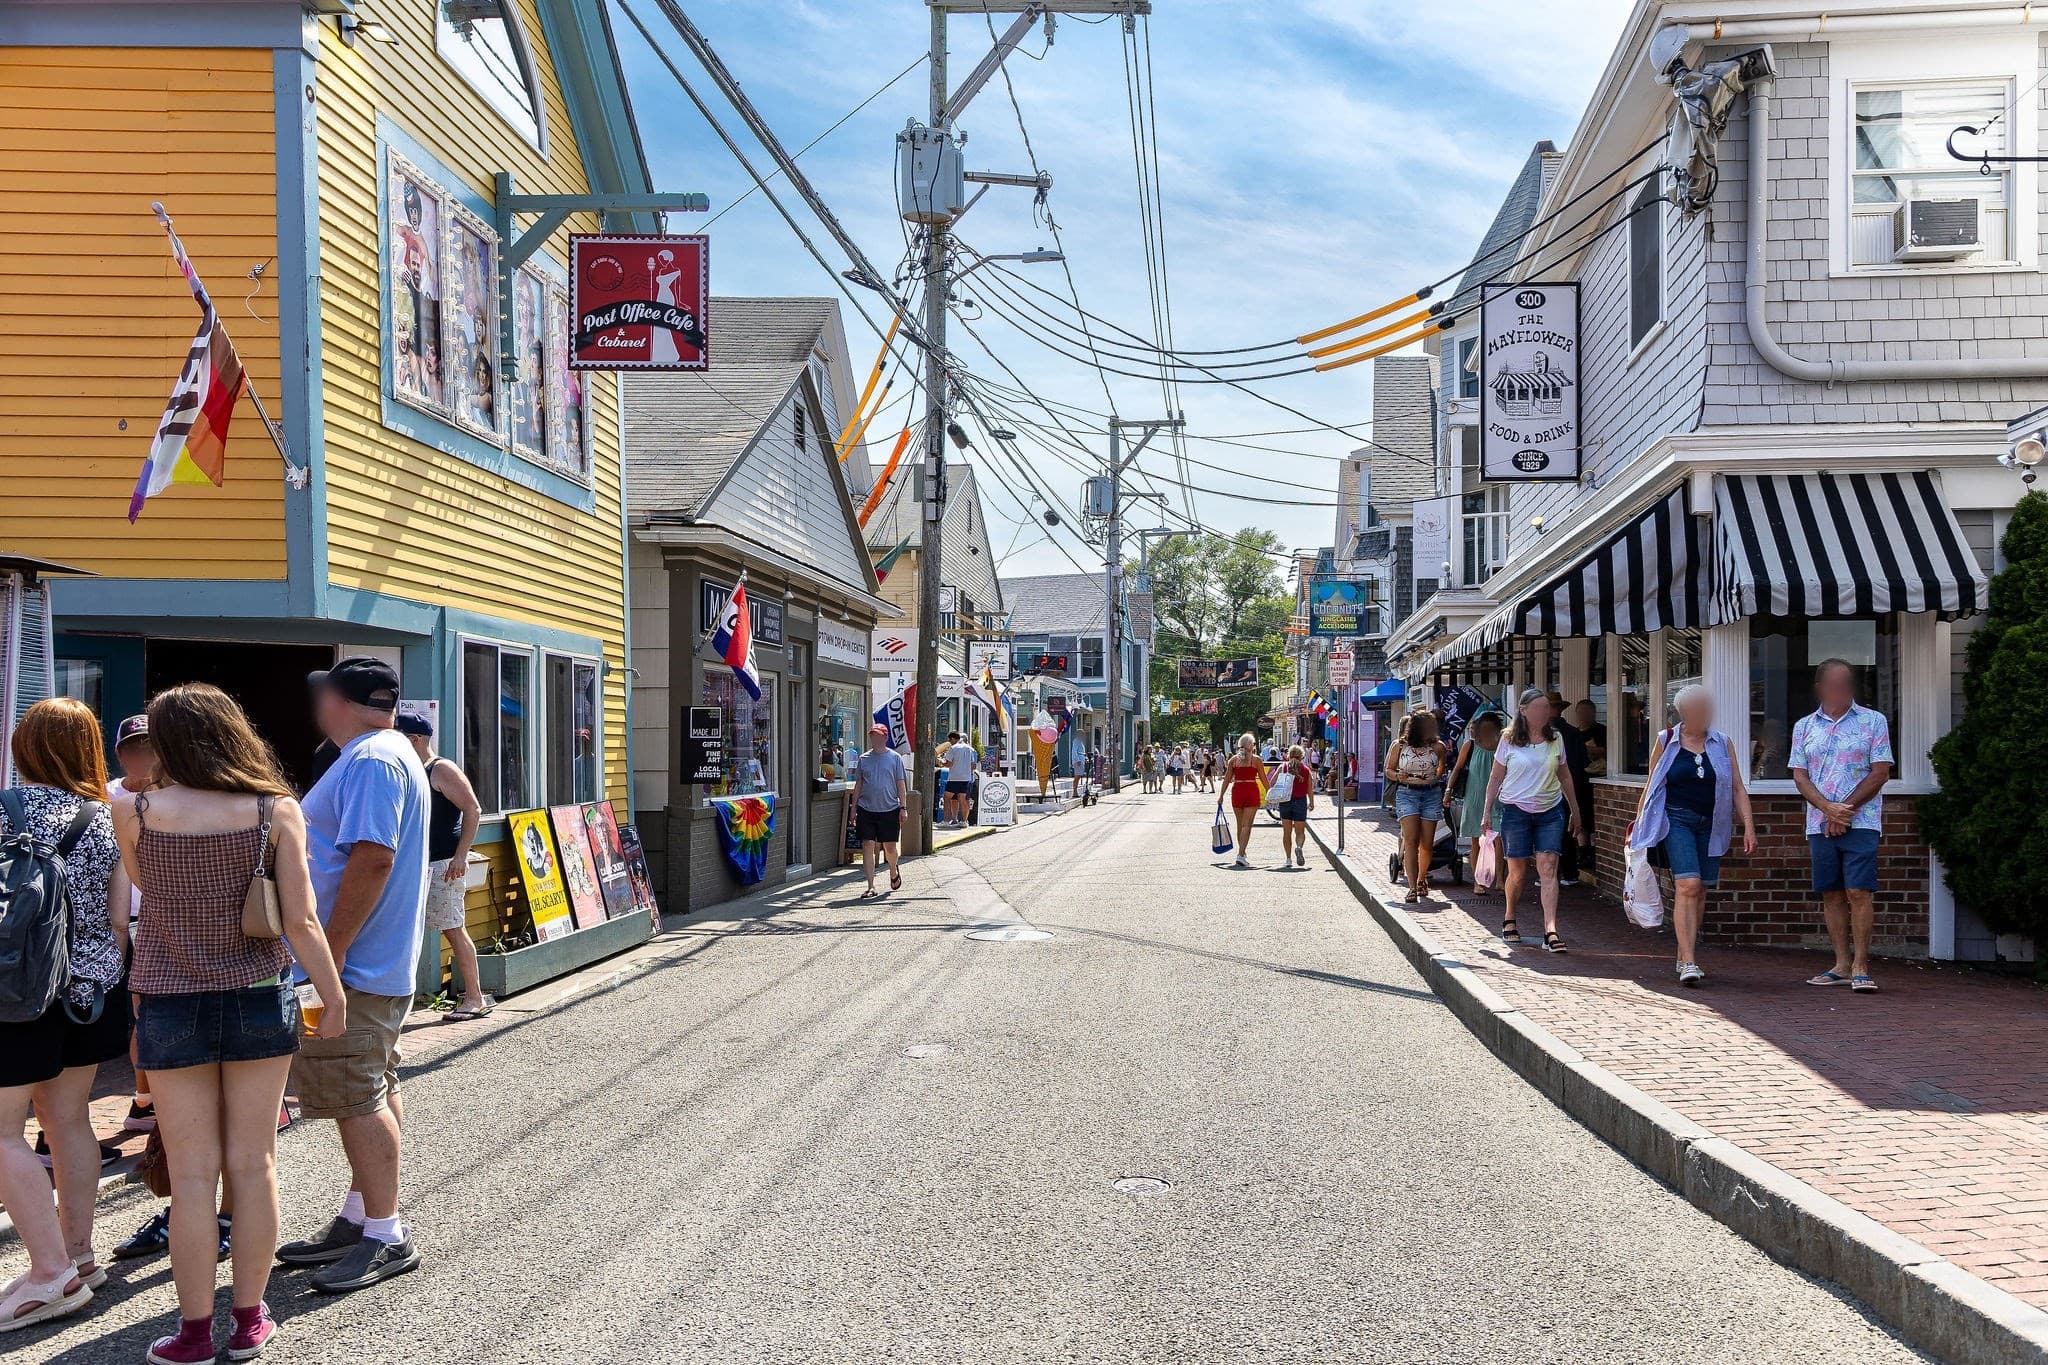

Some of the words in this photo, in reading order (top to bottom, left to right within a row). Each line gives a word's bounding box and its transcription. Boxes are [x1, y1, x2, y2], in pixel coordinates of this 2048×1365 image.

[1519, 293, 1541, 306] 300
[583, 308, 616, 333] Post
[620, 303, 662, 323] Office
[664, 308, 694, 331] Cafe
[1518, 314, 1544, 325] THE
[618, 328, 626, 336] &
[597, 336, 647, 348] Cabaret
[1487, 330, 1574, 357] MAYFLOWER
[1489, 422, 1520, 444] FOOD
[1523, 434, 1531, 444] &
[1534, 421, 1574, 445] DRINK
[1517, 452, 1544, 462] SINCE
[1522, 461, 1541, 471] 1929
[1313, 603, 1363, 615] COCONUTS
[851, 642, 866, 656] CENTER
[889, 697, 906, 749] OPEN
[692, 728, 709, 736] MADE
